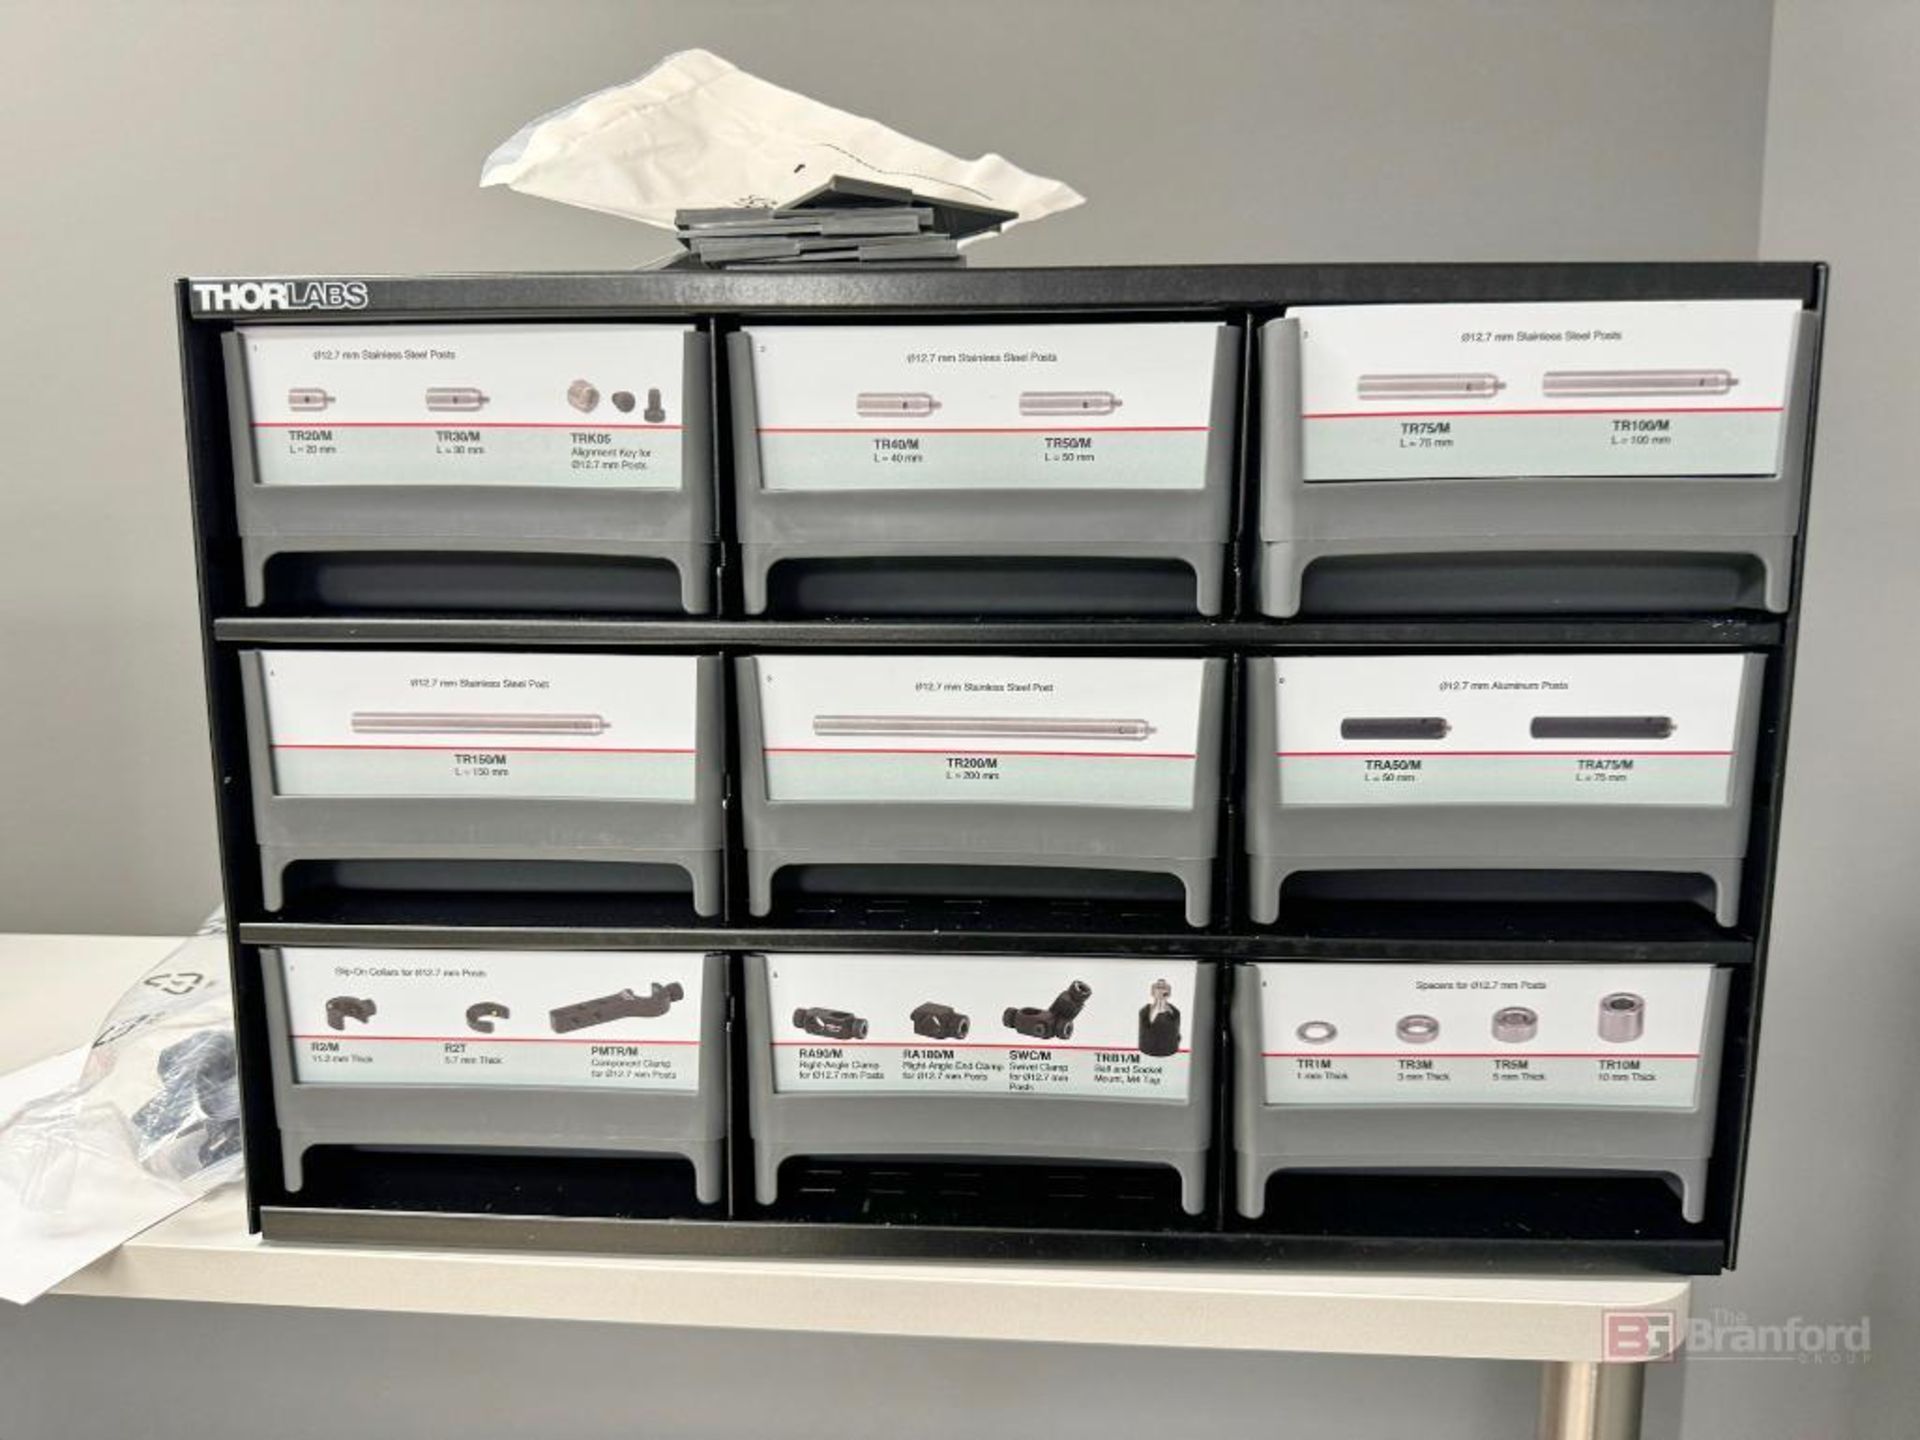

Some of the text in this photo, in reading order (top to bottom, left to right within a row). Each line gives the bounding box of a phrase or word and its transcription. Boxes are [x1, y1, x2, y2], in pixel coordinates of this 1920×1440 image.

[193, 282, 368, 311] THORLABS
[1461, 330, 1622, 342] Ø12.7 mm Stainless Steel Posts
[313, 350, 340, 360] Ø12.7
[362, 350, 403, 360] Stainless
[404, 350, 428, 360] Steel
[430, 350, 456, 359] Posts
[907, 354, 936, 363] Ø12.7
[958, 353, 1002, 362] Stainless
[1004, 352, 1028, 362] Steel
[1030, 352, 1057, 362] Posts
[1401, 422, 1450, 434] TR75/M
[1613, 420, 1669, 431] TR100/M
[288, 430, 332, 441] TR20/M
[436, 431, 480, 442] TR30/M
[570, 433, 611, 444] TRK05
[1611, 436, 1618, 445] L
[1631, 435, 1650, 444] 100
[874, 439, 919, 450] TR40/M
[1045, 438, 1091, 448] TR50/M
[1400, 438, 1408, 448] L
[1419, 438, 1432, 447] 75
[290, 445, 296, 454] L
[306, 445, 317, 454] 20
[436, 446, 442, 454] L
[454, 445, 465, 454] 30
[571, 448, 651, 459] Alignment Key for
[874, 453, 923, 463] L 40 mm
[1045, 453, 1051, 461] L
[1062, 453, 1074, 461] 50
[571, 460, 600, 469] Ø12.7
[621, 460, 648, 469] Posts
[410, 679, 437, 687] Ø12.7
[460, 679, 500, 688] Stainless
[503, 679, 526, 688] Steel
[528, 680, 549, 688] Post
[915, 683, 942, 691] Ø12.7
[964, 683, 1004, 691] Stainless
[1007, 683, 1031, 691] Steel
[1032, 683, 1053, 692] Post
[1439, 681, 1568, 690] Ø12.7 mm Aluminum Posts
[454, 754, 506, 764] TR150/M
[946, 758, 997, 768] TR200/M
[1365, 760, 1422, 770] TRA50/M
[1577, 760, 1634, 770] TRA75/M
[455, 768, 462, 776] L
[474, 768, 489, 776] 150
[963, 771, 980, 779] 200
[1382, 773, 1395, 781] 50
[1594, 773, 1607, 782] 75
[369, 968, 399, 976] Collars
[462, 969, 486, 977] Posts
[1416, 981, 1454, 990] Spacers
[1470, 981, 1498, 989] Ø12.7
[1521, 981, 1546, 989] Posts
[311, 1042, 339, 1051] R2/M
[444, 1043, 466, 1053] R2T
[591, 1046, 638, 1056] PMTR/M
[351, 1054, 373, 1063] Thick
[799, 1049, 843, 1058] RA90/M
[1009, 1050, 1051, 1060] SWC/M
[480, 1056, 502, 1064] Thick
[643, 1060, 671, 1068] Clamp
[1296, 1059, 1331, 1068] TR1M
[1398, 1060, 1432, 1069] TR3M
[1494, 1060, 1528, 1069] TR5M
[1599, 1060, 1640, 1070] TR10M
[852, 1061, 880, 1072] Clamp
[955, 1061, 1004, 1072] End Clamp
[1039, 1064, 1068, 1074] Clamp
[1113, 1066, 1130, 1074] and
[1133, 1065, 1162, 1074] Socket
[591, 1070, 603, 1078] for
[605, 1069, 632, 1078] Ø12.7
[652, 1071, 676, 1079] Posts
[799, 1071, 810, 1079] for
[812, 1071, 839, 1079] Ø12.7
[860, 1071, 884, 1079] Posts
[917, 1071, 942, 1079] Ø12.7
[964, 1073, 988, 1081] Posts
[1022, 1073, 1049, 1081] Ø12.7
[1051, 1072, 1068, 1082] mm
[1127, 1075, 1140, 1083] M4
[1325, 1071, 1348, 1079] Thick
[1426, 1072, 1450, 1080] Thick
[1598, 1073, 1610, 1081] 10
[1631, 1072, 1656, 1081] Thick
